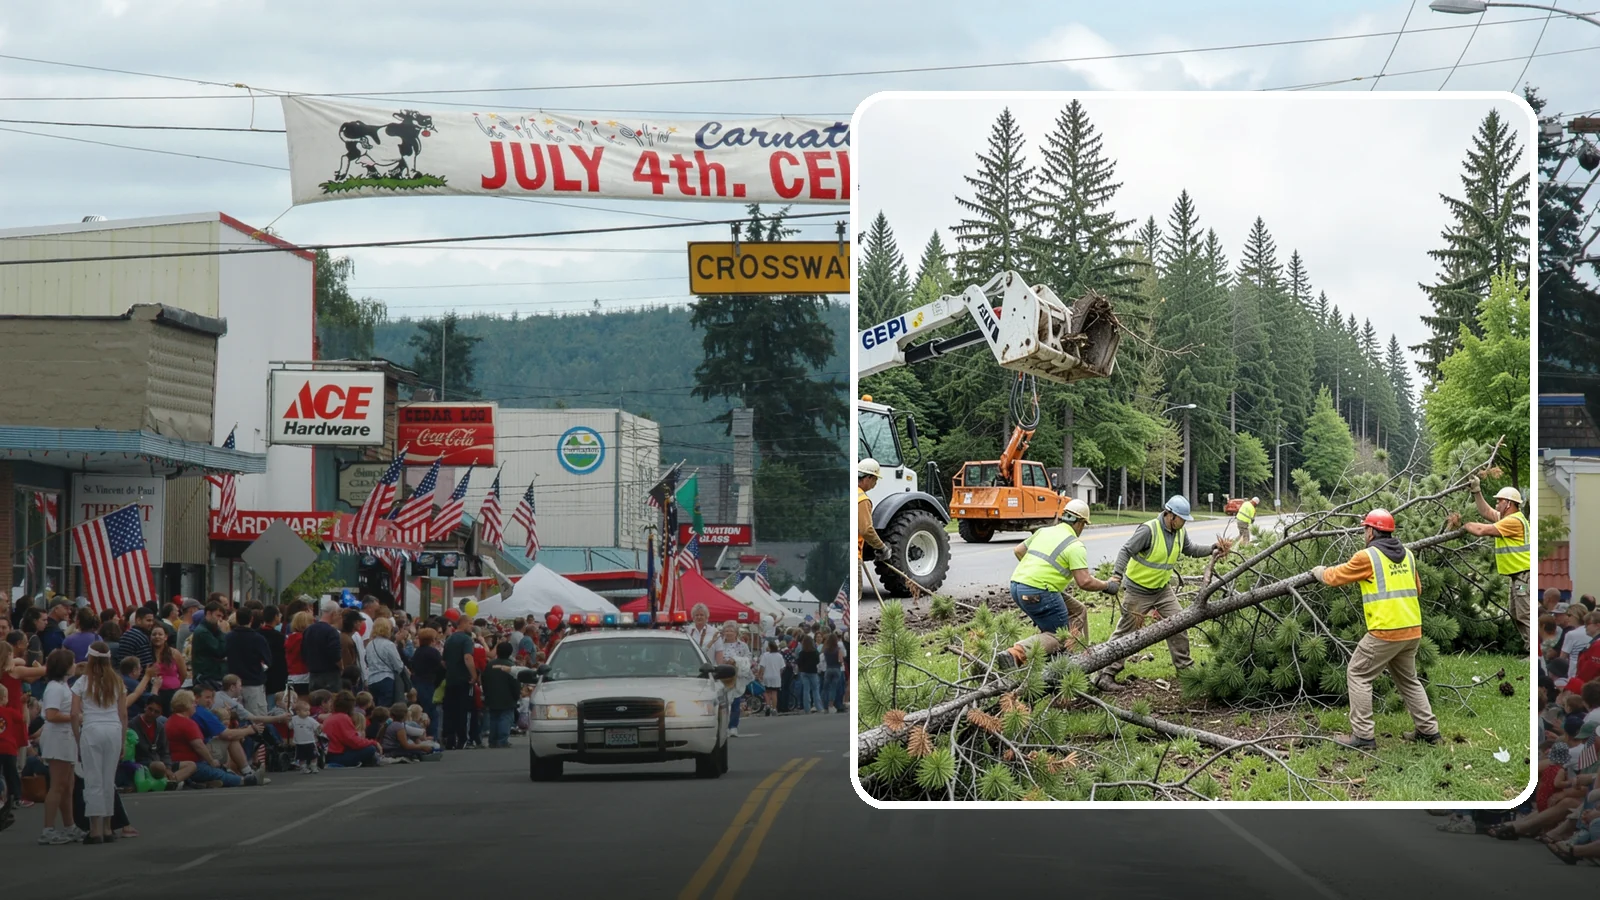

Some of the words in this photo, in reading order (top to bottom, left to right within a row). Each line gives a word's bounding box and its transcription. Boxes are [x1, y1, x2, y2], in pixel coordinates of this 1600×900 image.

[481, 141, 605, 192] JULY
[632, 150, 747, 197] 4th.
[697, 254, 849, 280] CROSSWA
[862, 316, 908, 350] GEPI
[282, 380, 374, 420] ACE
[405, 409, 453, 421] CEDAR
[283, 421, 371, 436] Hardware
[354, 467, 385, 479] Simpl
[83, 485, 94, 494] St.
[96, 485, 125, 495] Vincent
[126, 486, 136, 495] de
[138, 486, 155, 495] Paul
[81, 503, 154, 522] THT
[213, 516, 330, 535] HARDARE
[688, 527, 741, 535] CRNATION
[699, 535, 730, 543] GLASS
